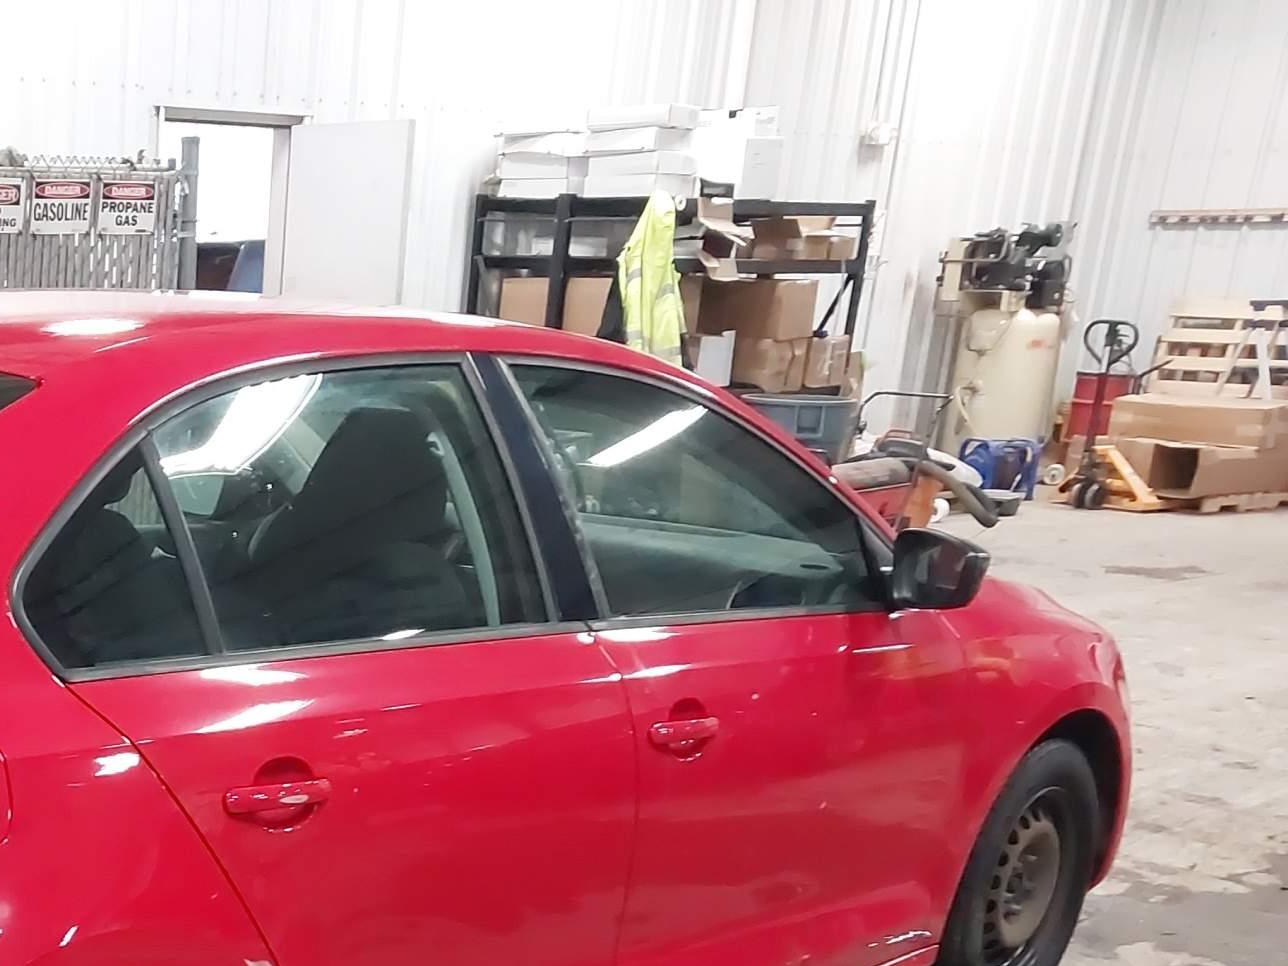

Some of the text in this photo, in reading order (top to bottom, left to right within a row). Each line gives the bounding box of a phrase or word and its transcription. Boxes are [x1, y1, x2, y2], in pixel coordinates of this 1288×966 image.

[44, 185, 81, 195] DANGER
[111, 186, 147, 196] DANGER
[33, 202, 89, 221] GASOLINE
[101, 201, 154, 213] PROPANE
[115, 215, 138, 226] GAS
